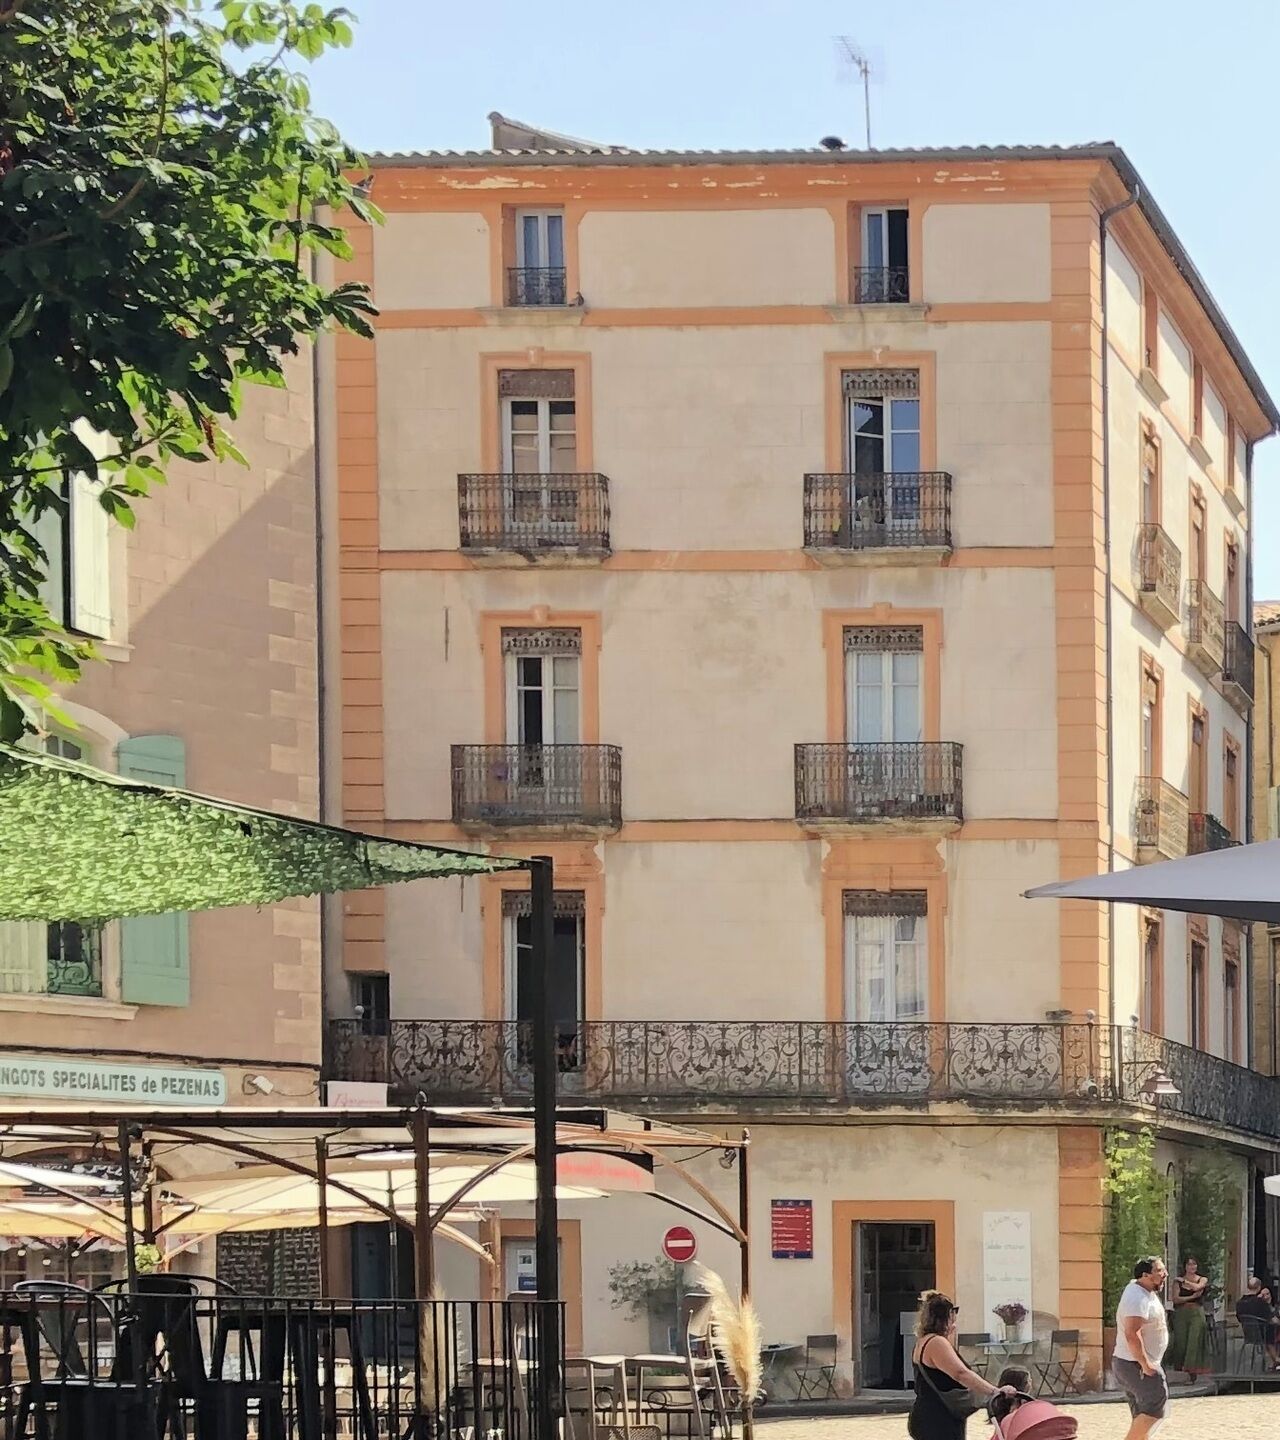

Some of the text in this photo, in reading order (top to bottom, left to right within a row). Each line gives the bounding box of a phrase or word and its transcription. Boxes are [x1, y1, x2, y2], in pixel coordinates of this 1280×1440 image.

[53, 1070, 137, 1093] SPECIALITES
[141, 1076, 157, 1093] de
[161, 1077, 220, 1097] PEZENAS
